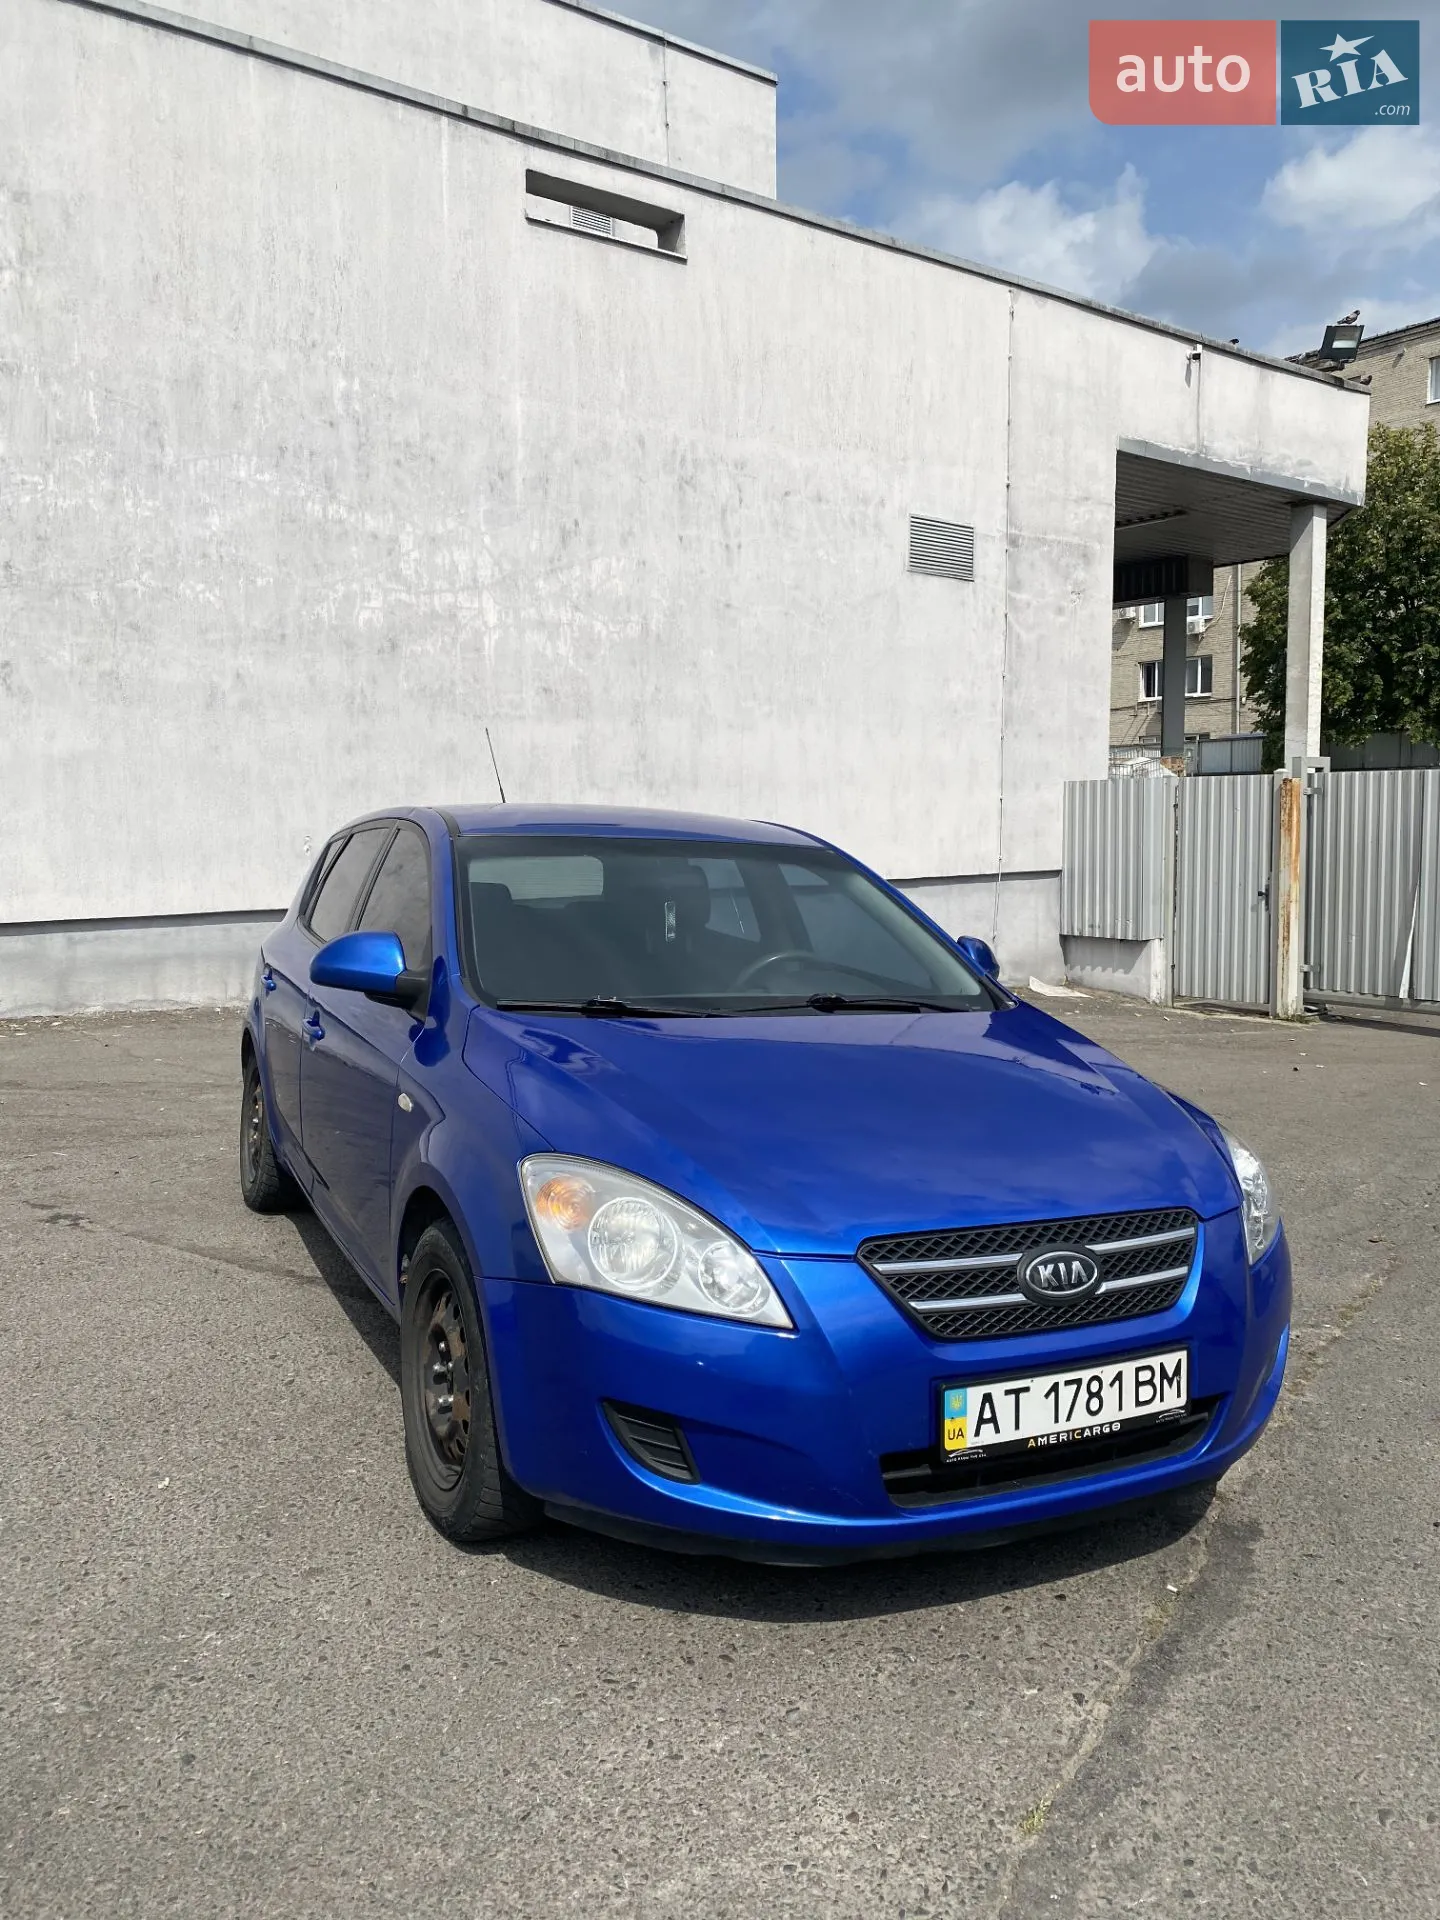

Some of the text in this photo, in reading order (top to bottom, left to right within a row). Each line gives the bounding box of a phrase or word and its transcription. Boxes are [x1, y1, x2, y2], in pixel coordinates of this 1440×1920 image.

[1037, 1261, 1089, 1288] KIA
[973, 1358, 1182, 1438] AT 1781 BM
[947, 1426, 965, 1441] UA
[1027, 1422, 1121, 1448] AMERICARGO
